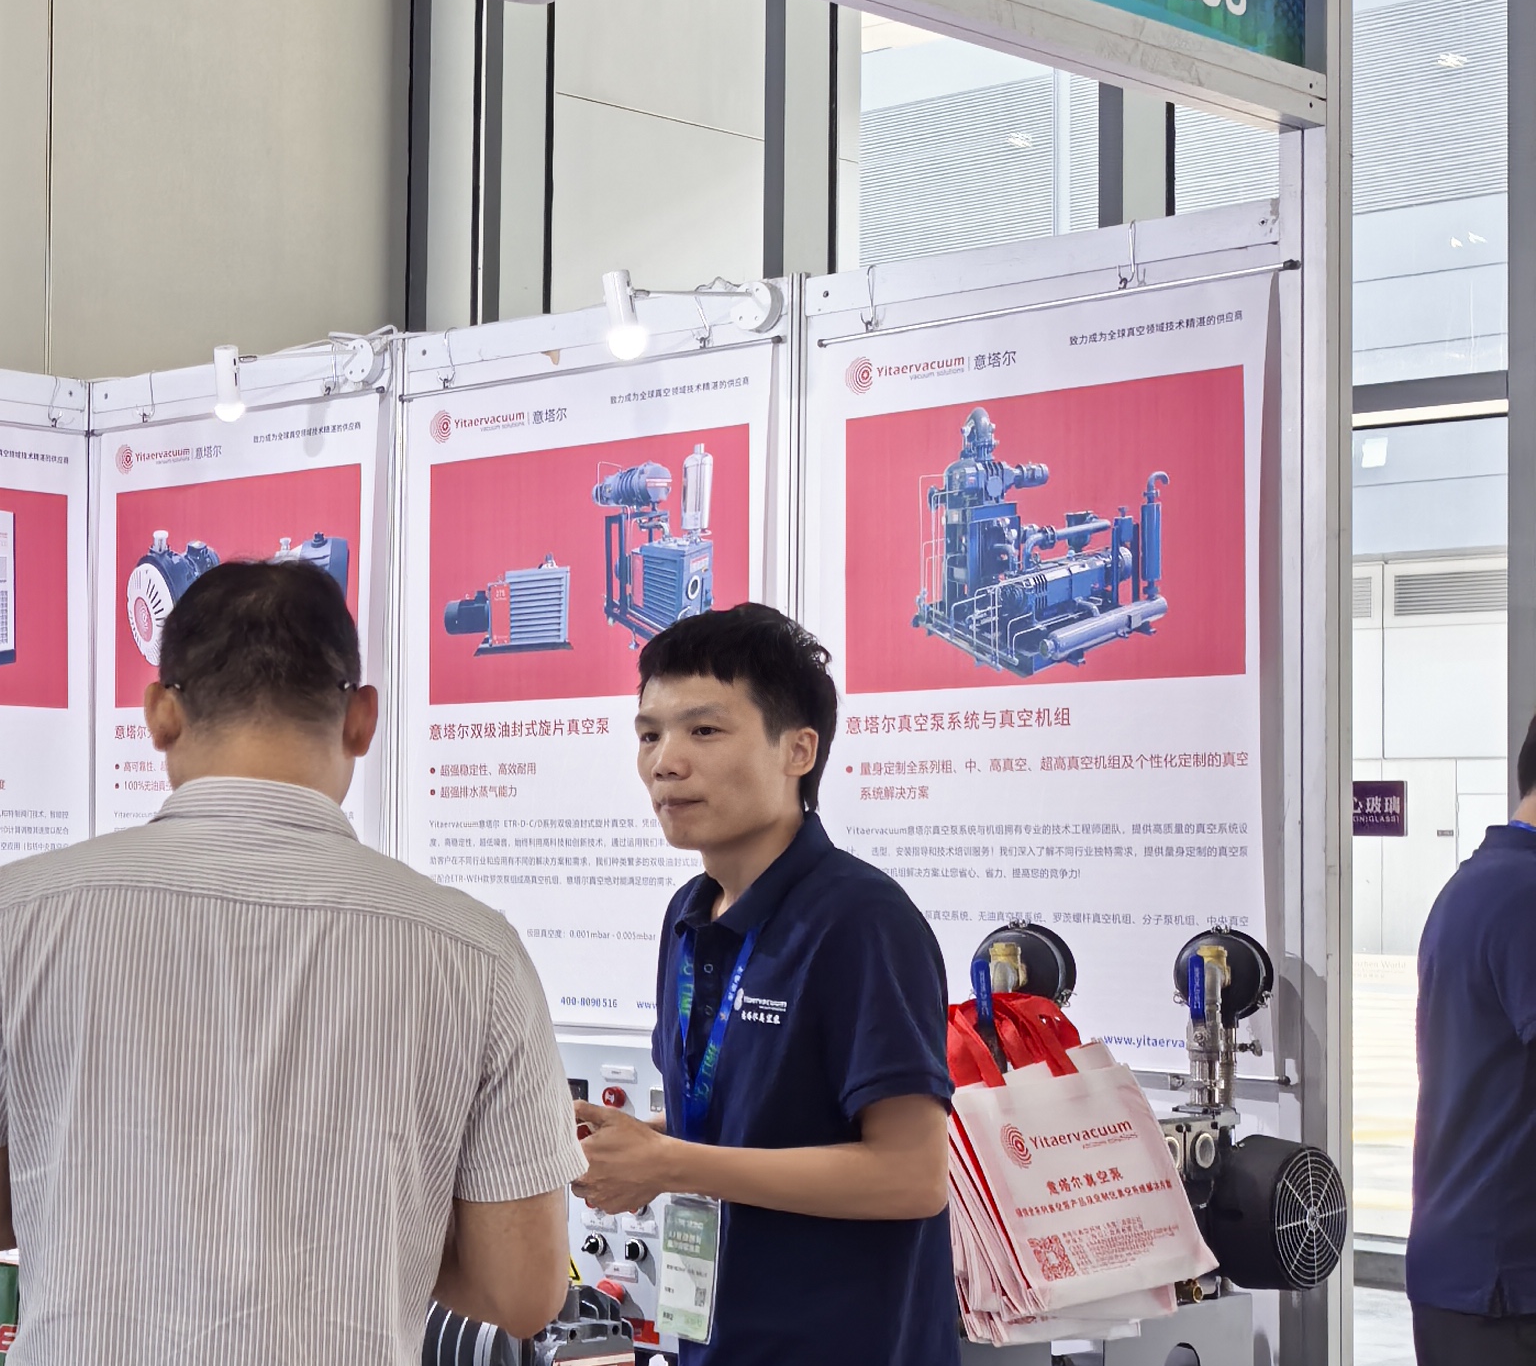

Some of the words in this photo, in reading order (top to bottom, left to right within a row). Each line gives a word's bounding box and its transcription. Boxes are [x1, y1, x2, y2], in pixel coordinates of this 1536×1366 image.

[876, 354, 965, 378] Yitaervacuum
[973, 350, 1017, 371] 意塔尔
[455, 411, 525, 429] Yitaervacuum
[532, 407, 568, 425] 意塔尔
[195, 445, 222, 460] 意塔尔
[429, 717, 610, 741] 意塔尔双级油封式旋片真空泵
[845, 707, 1072, 736] 意塔尔真空泵系统与真空机组
[859, 785, 929, 801] 系统解决方案
[1030, 1120, 1133, 1150] Yitaervacuum
